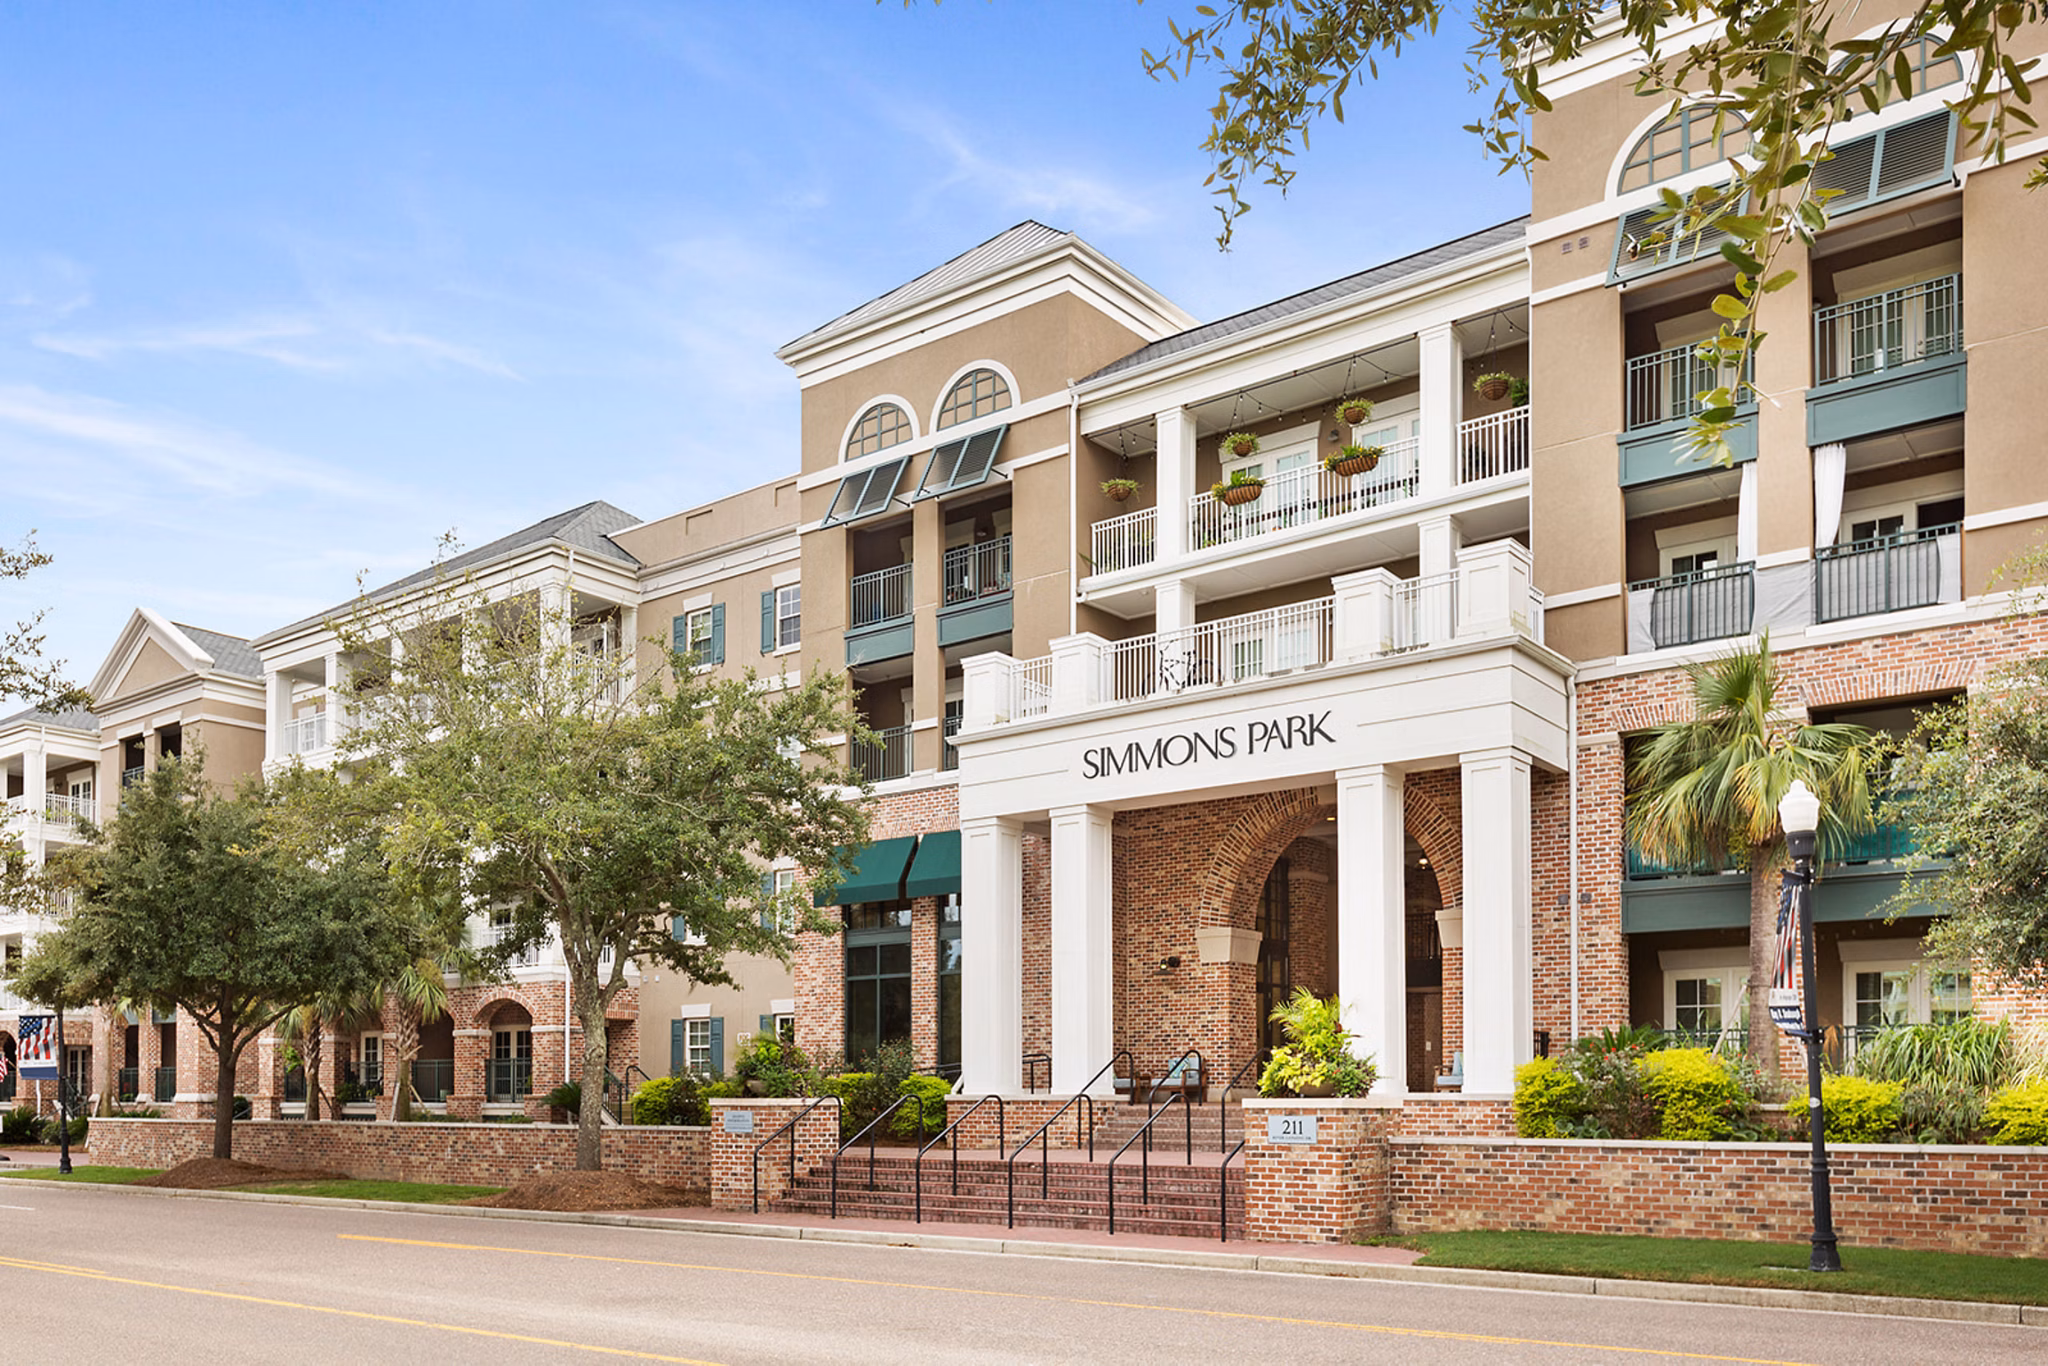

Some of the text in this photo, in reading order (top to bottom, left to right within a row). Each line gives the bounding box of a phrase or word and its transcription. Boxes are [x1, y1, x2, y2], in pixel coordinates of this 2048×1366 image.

[1083, 710, 1337, 780] SIMMONS PARK
[1282, 1119, 1303, 1135] 211
